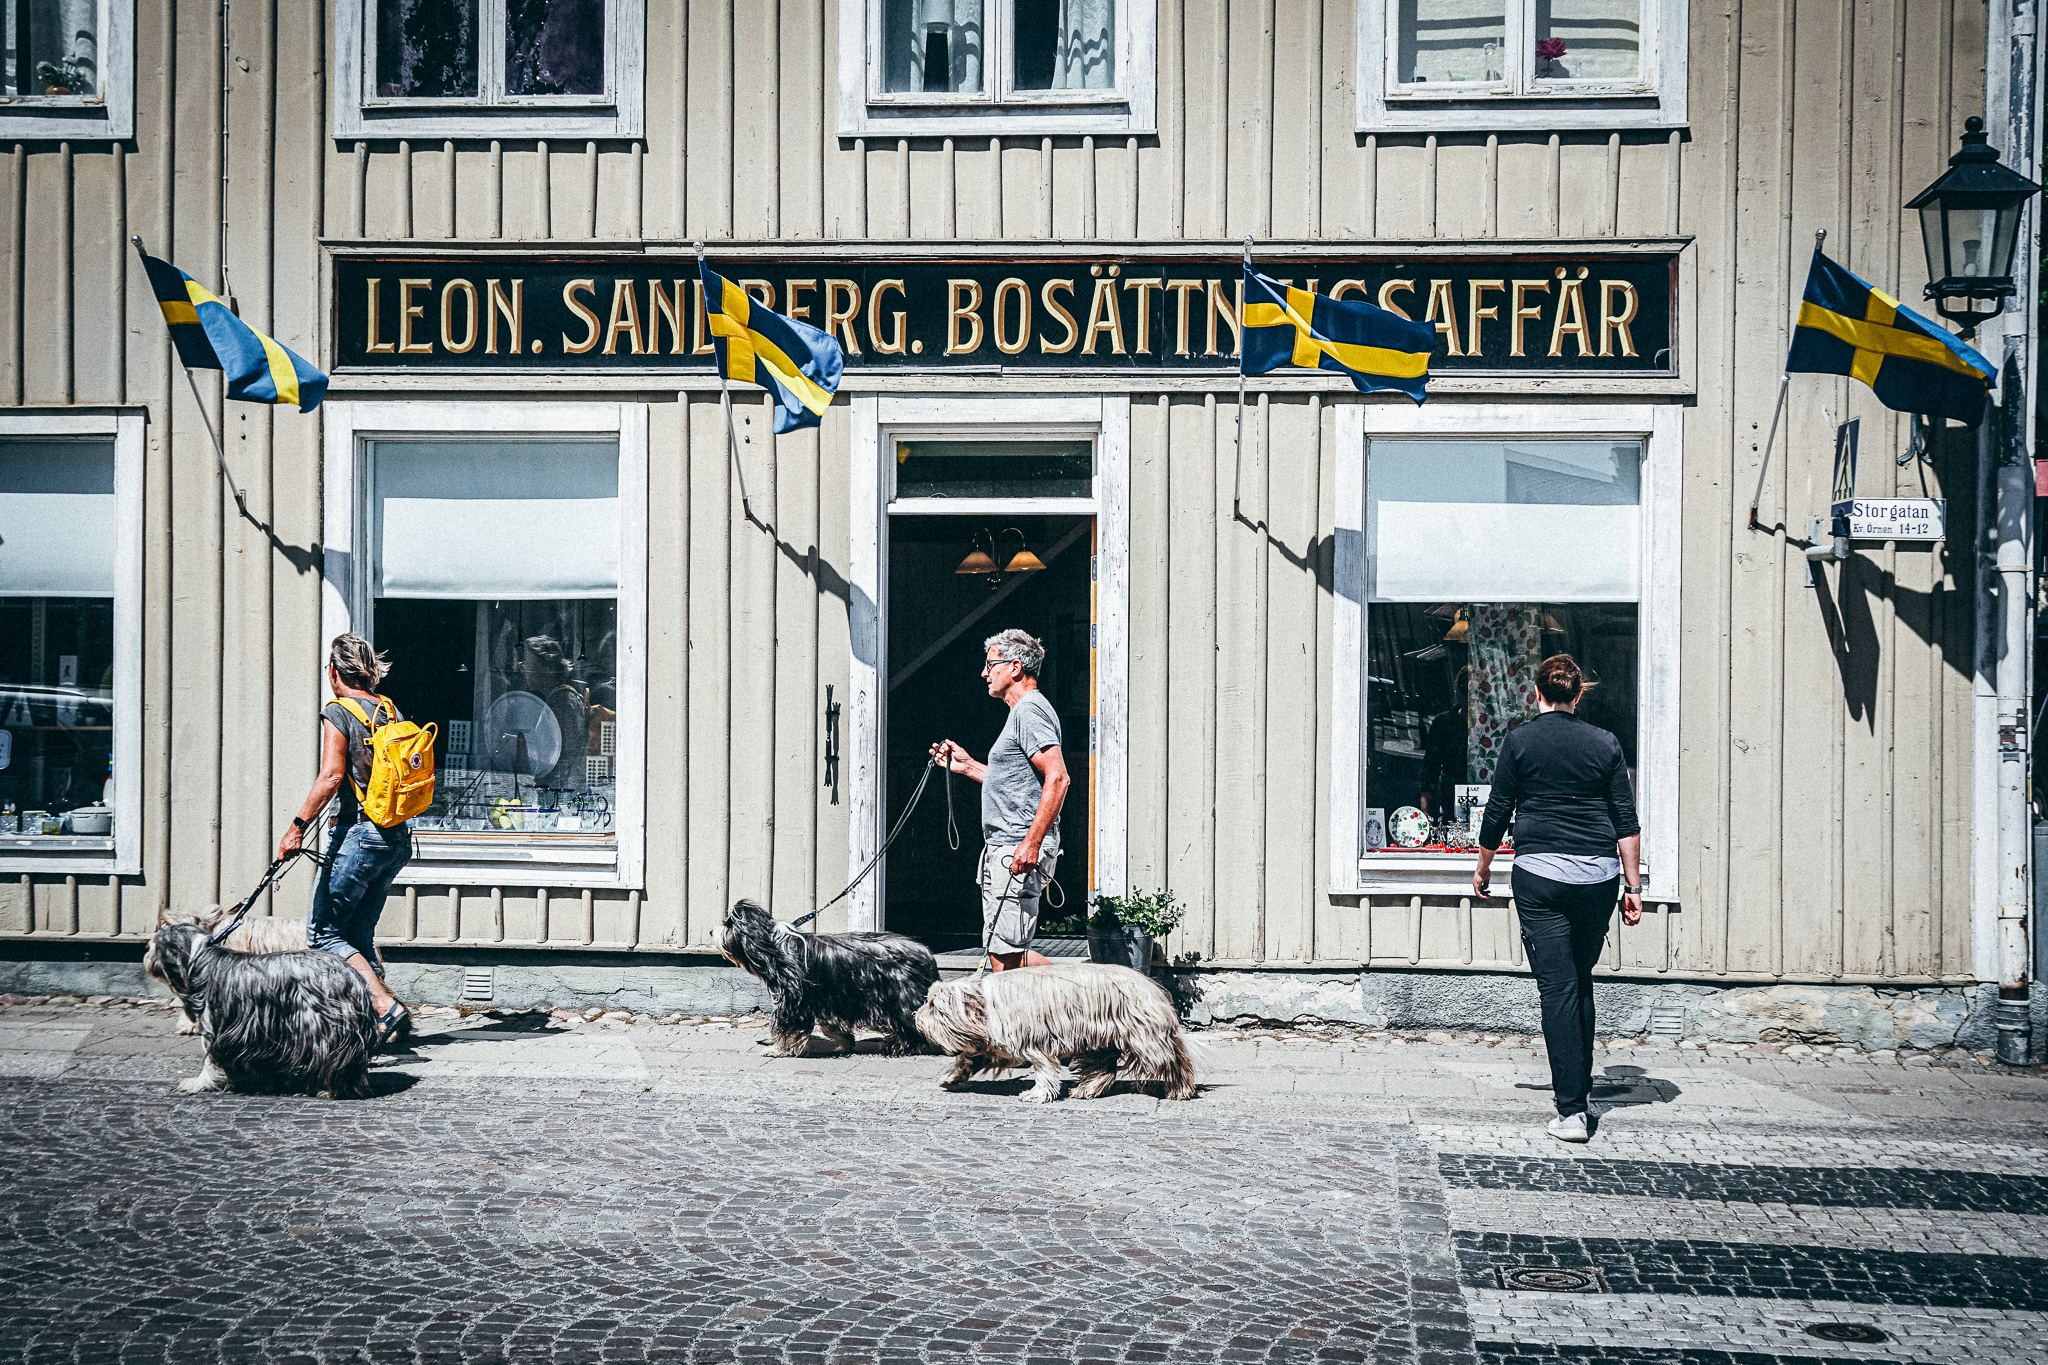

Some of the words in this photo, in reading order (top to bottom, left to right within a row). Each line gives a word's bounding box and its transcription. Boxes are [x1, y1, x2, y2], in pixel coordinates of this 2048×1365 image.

[366, 277, 544, 355] LEON.
[1853, 502, 1929, 521] Storgatan
[1900, 523, 1928, 534] 14-12
